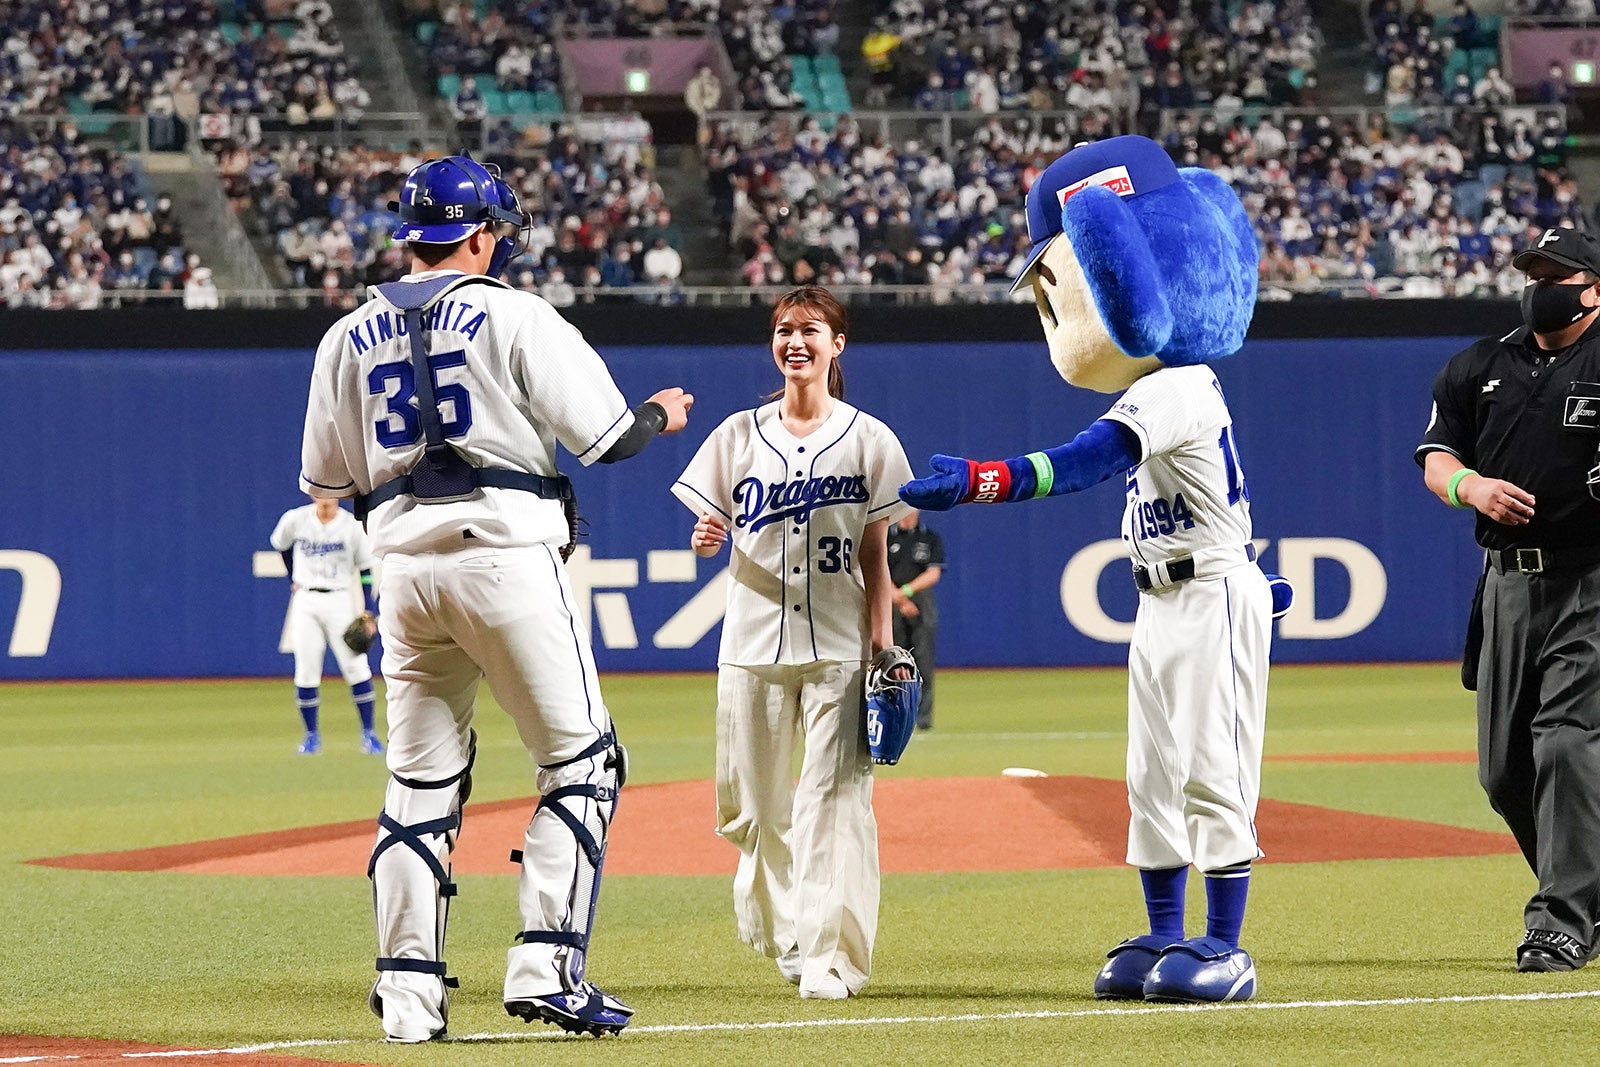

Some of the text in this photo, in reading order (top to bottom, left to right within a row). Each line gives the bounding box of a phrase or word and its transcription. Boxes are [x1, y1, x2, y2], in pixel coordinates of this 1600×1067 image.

[445, 205, 464, 219] 35
[405, 230, 423, 241] 35
[349, 300, 487, 356] KINOHITA
[368, 349, 473, 449] 35
[732, 474, 870, 534] Dragons
[973, 469, 1000, 503] 1994
[1138, 493, 1195, 541] 1994
[817, 536, 853, 575] 36
